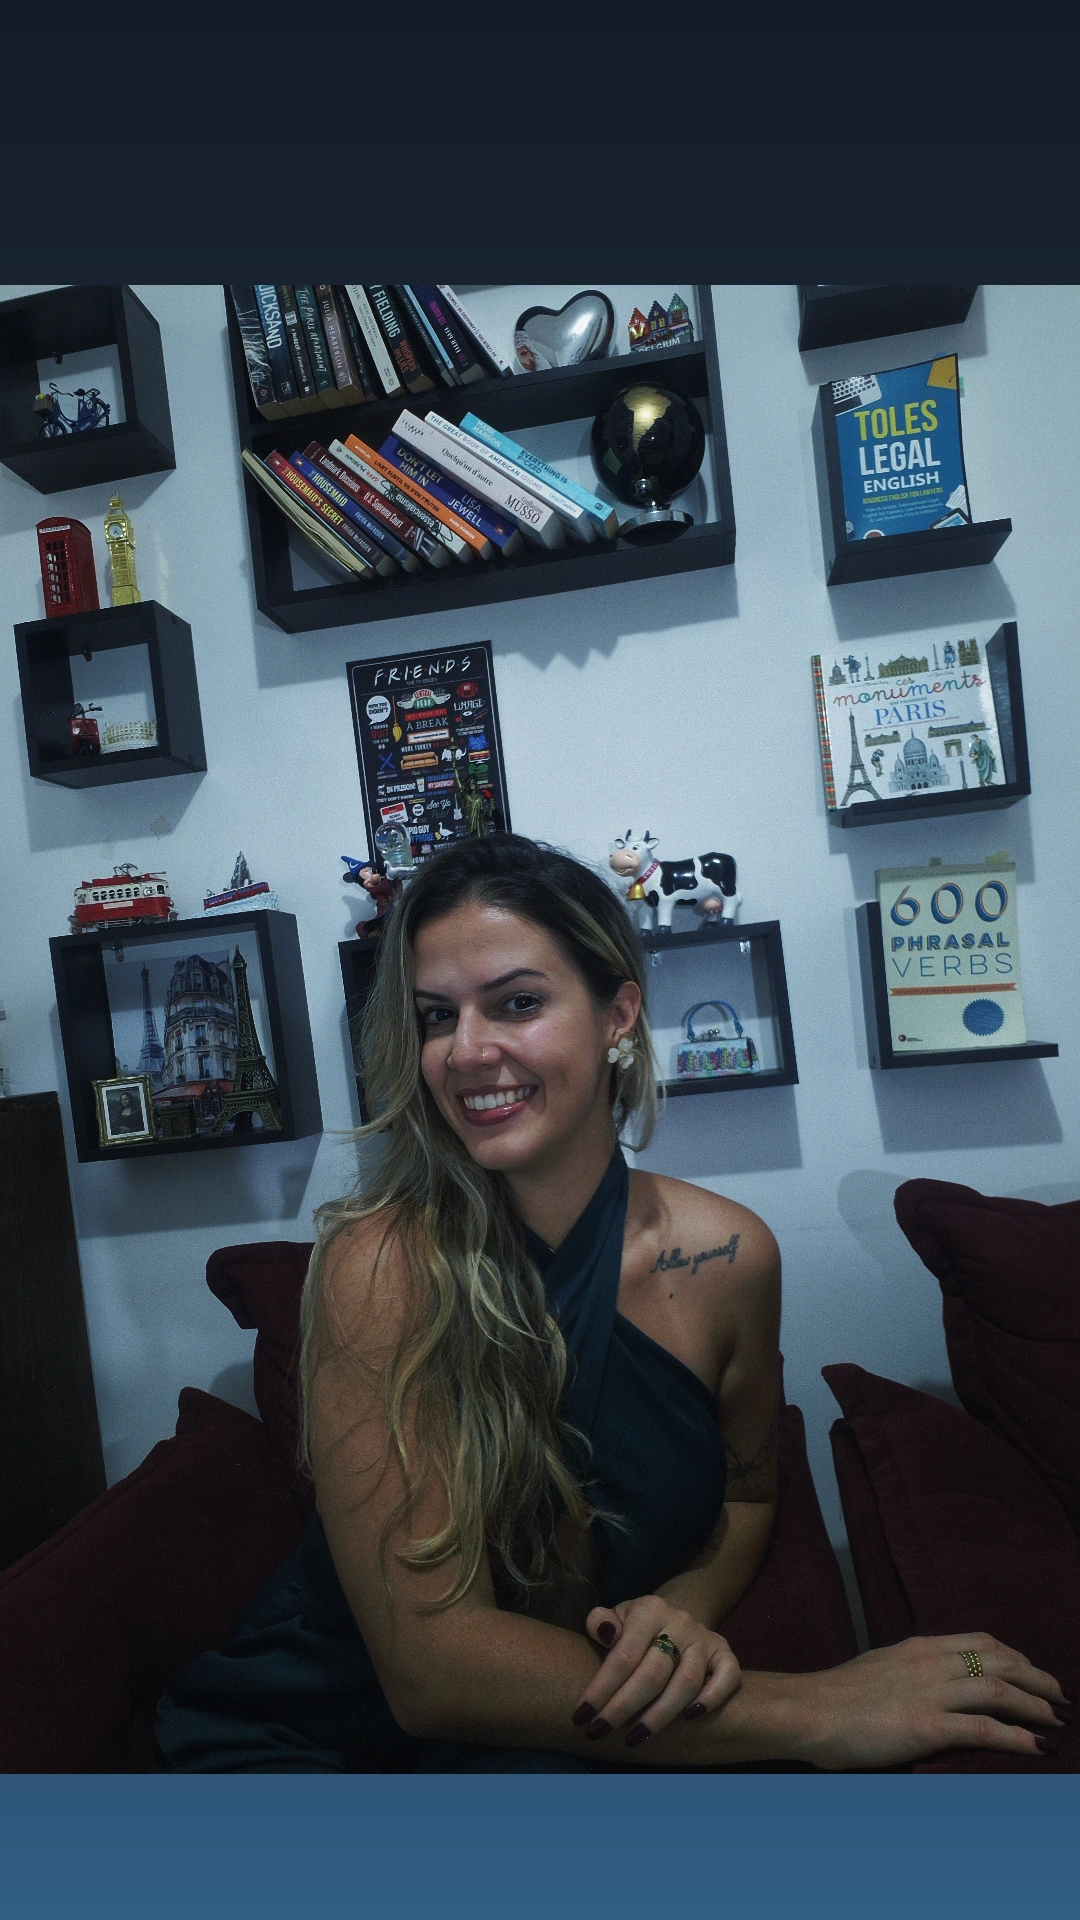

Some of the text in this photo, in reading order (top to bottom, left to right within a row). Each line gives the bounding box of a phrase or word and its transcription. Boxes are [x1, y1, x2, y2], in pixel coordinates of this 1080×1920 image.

[322, 299, 333, 321] JULIA
[373, 290, 400, 338] FIELDING
[297, 287, 326, 373] THE PARIS APARTMENT
[327, 324, 342, 369] HEABERLIN
[400, 339, 417, 371] WHISPERS
[475, 419, 495, 435] MARK
[854, 399, 938, 441] TOLES
[472, 425, 502, 448] MANSON
[397, 447, 429, 473] DON'T
[425, 467, 443, 485] LET
[430, 416, 442, 426] THE
[442, 424, 461, 439] GREAT
[462, 436, 478, 449] BOOK
[479, 448, 489, 456] OF
[488, 454, 520, 476] AMERICAN
[520, 474, 543, 491] IDIOMS
[441, 447, 494, 487] Quelqu'un d'autre
[520, 450, 568, 484] EVERYTHING IS
[859, 438, 941, 475] LEGAL
[319, 455, 361, 492] Landmark Decisions
[399, 461, 430, 487] HIM IN
[864, 471, 939, 493] ENGLISH
[285, 469, 322, 507] HOUSEMAID'S
[321, 503, 344, 526] SECRET
[311, 474, 348, 507] HOUSEMAID
[461, 494, 482, 513] LISA
[355, 511, 367, 525] FREIDA
[364, 491, 374, 504] U.S.
[370, 496, 393, 519] Supreme
[389, 513, 403, 529] Court
[396, 493, 435, 528] essencialismo
[447, 498, 483, 528] JEWELL
[505, 494, 541, 524] MUSSO
[342, 523, 355, 536] FREIDA
[833, 671, 986, 707] monuments
[896, 677, 915, 686] ces
[406, 717, 449, 731] A BREAK
[875, 700, 946, 726] PARIS
[419, 825, 429, 833] GUY
[891, 880, 1008, 926] 600
[892, 932, 1010, 951] PHRASAL
[892, 953, 1013, 978] VERBS
[650, 1234, 740, 1274] Allow yourself
